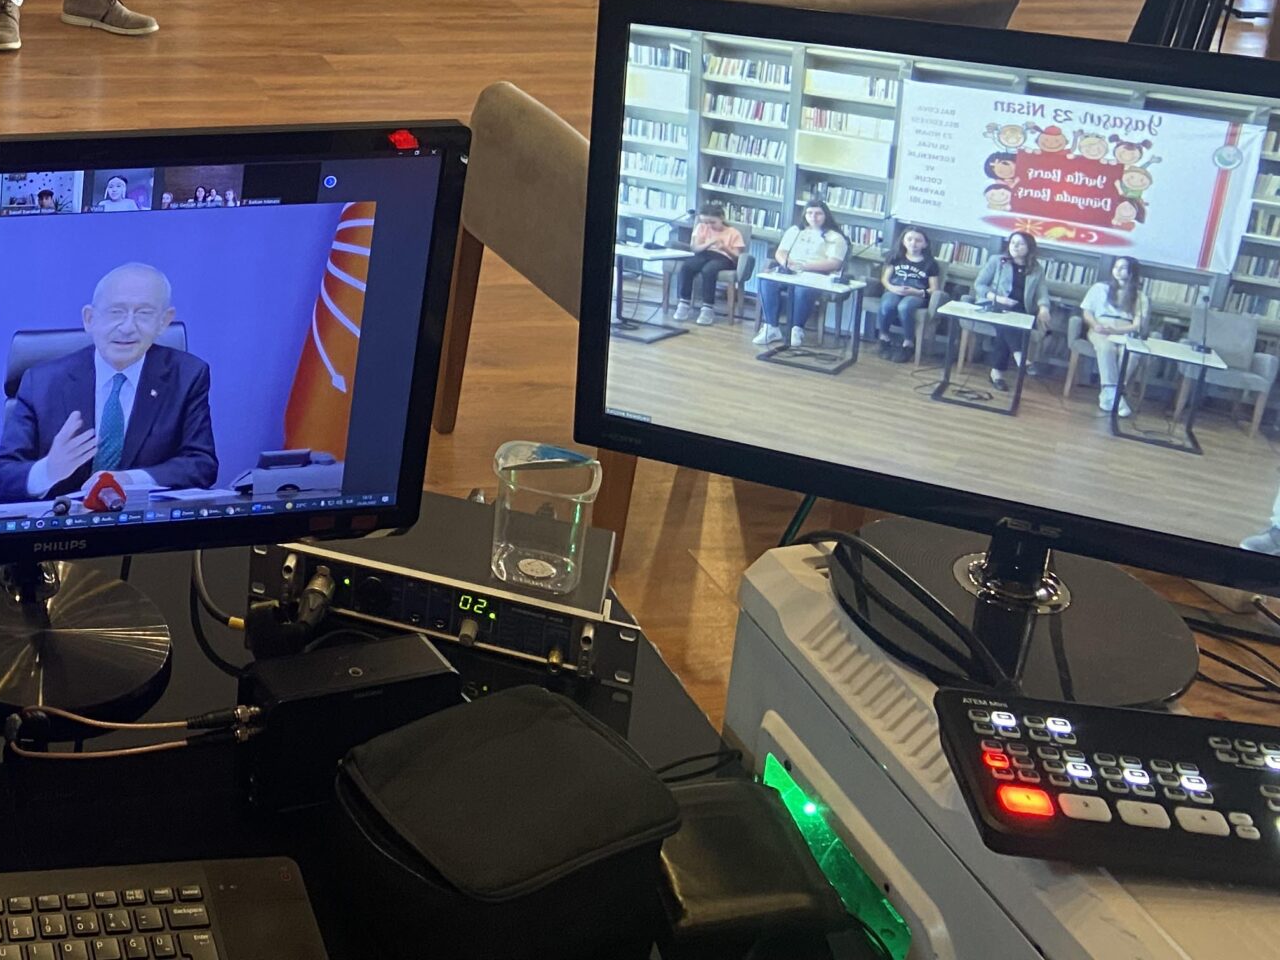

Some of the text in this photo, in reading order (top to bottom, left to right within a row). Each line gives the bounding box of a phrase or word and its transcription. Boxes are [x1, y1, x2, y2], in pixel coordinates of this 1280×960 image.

[34, 540, 87, 552] PHILIPS
[458, 595, 487, 614] 02
[963, 697, 987, 707] ATEM
